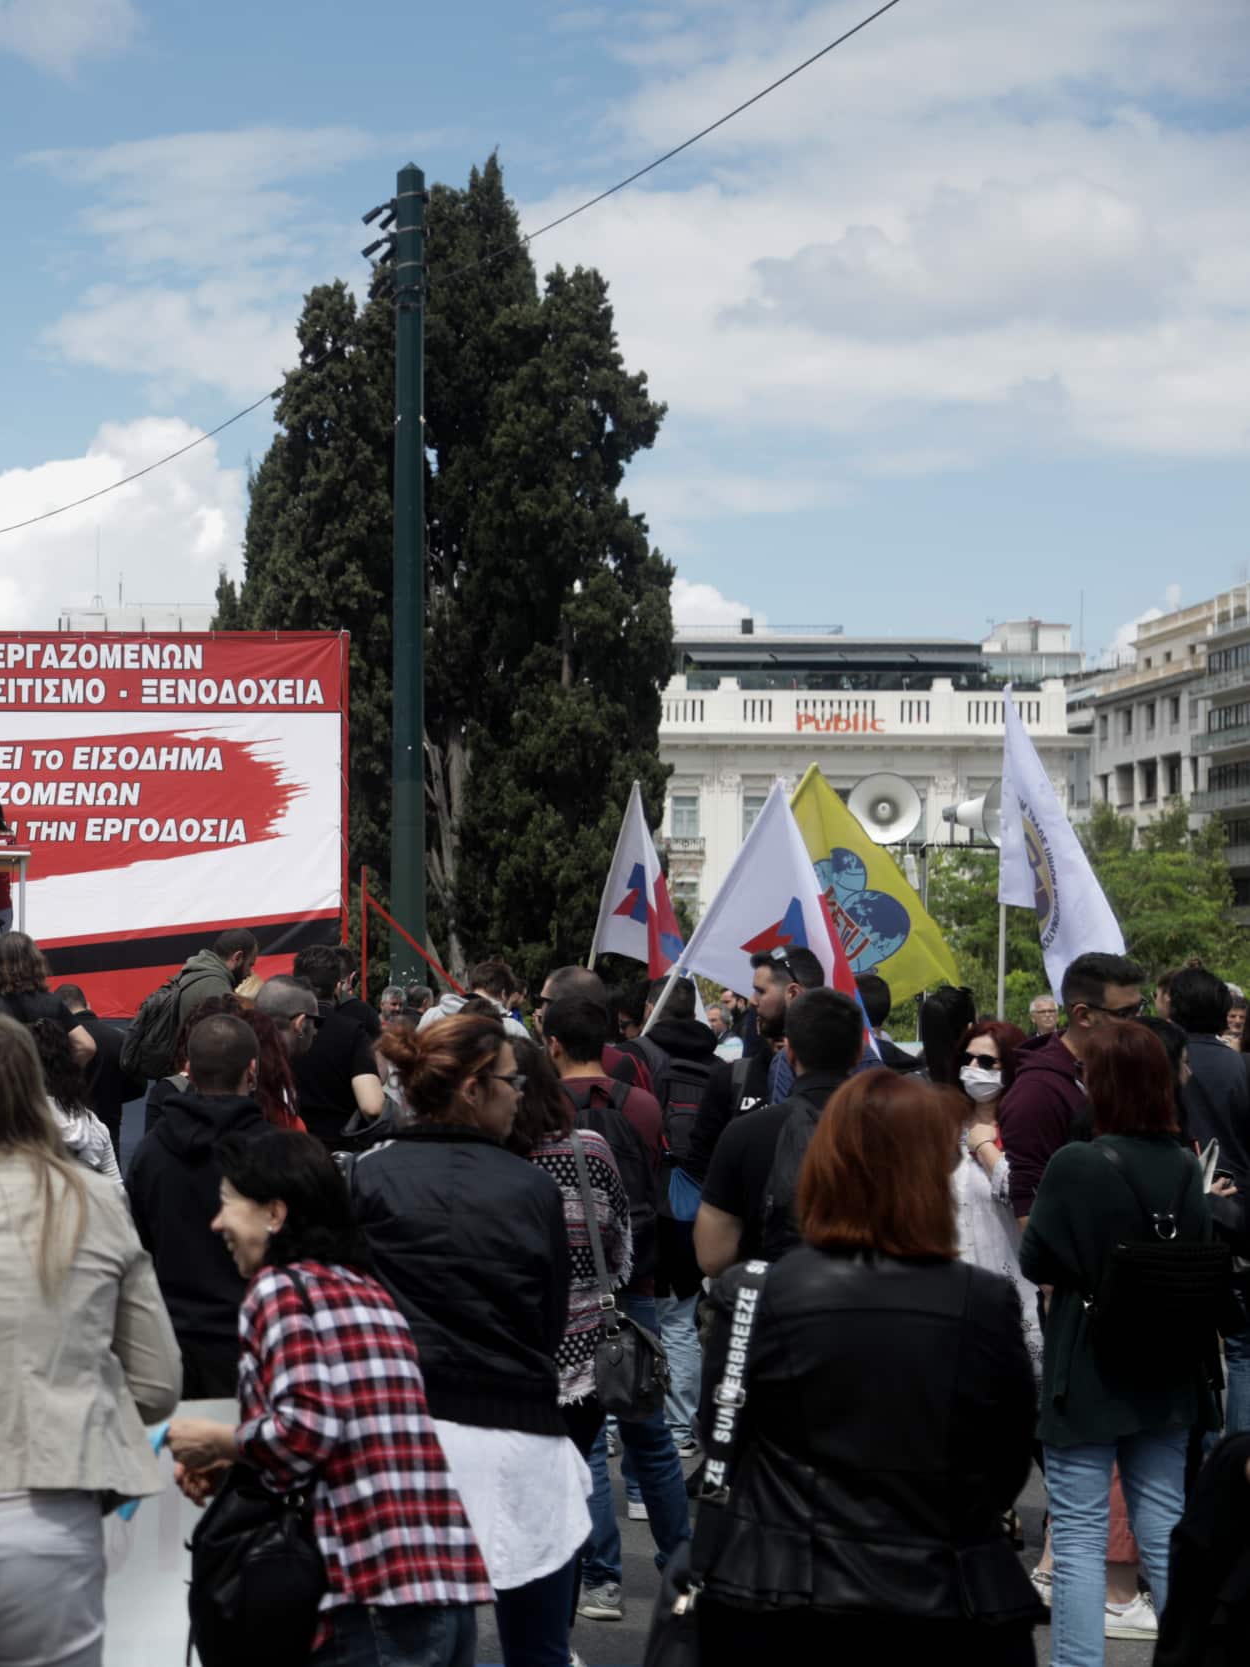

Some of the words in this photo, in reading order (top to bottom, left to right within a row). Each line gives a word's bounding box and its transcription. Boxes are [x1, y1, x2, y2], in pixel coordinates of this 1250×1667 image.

[141, 678, 325, 705] ΞΕΝΟΔΟΧΕΙΑ
[796, 711, 885, 732] Public
[71, 746, 224, 771] ΕΙΣΟΔΗΜΑ
[26, 821, 77, 842] ΤΗΝ
[84, 818, 247, 843] ΕΡΓΟΔΟΣΙΑ
